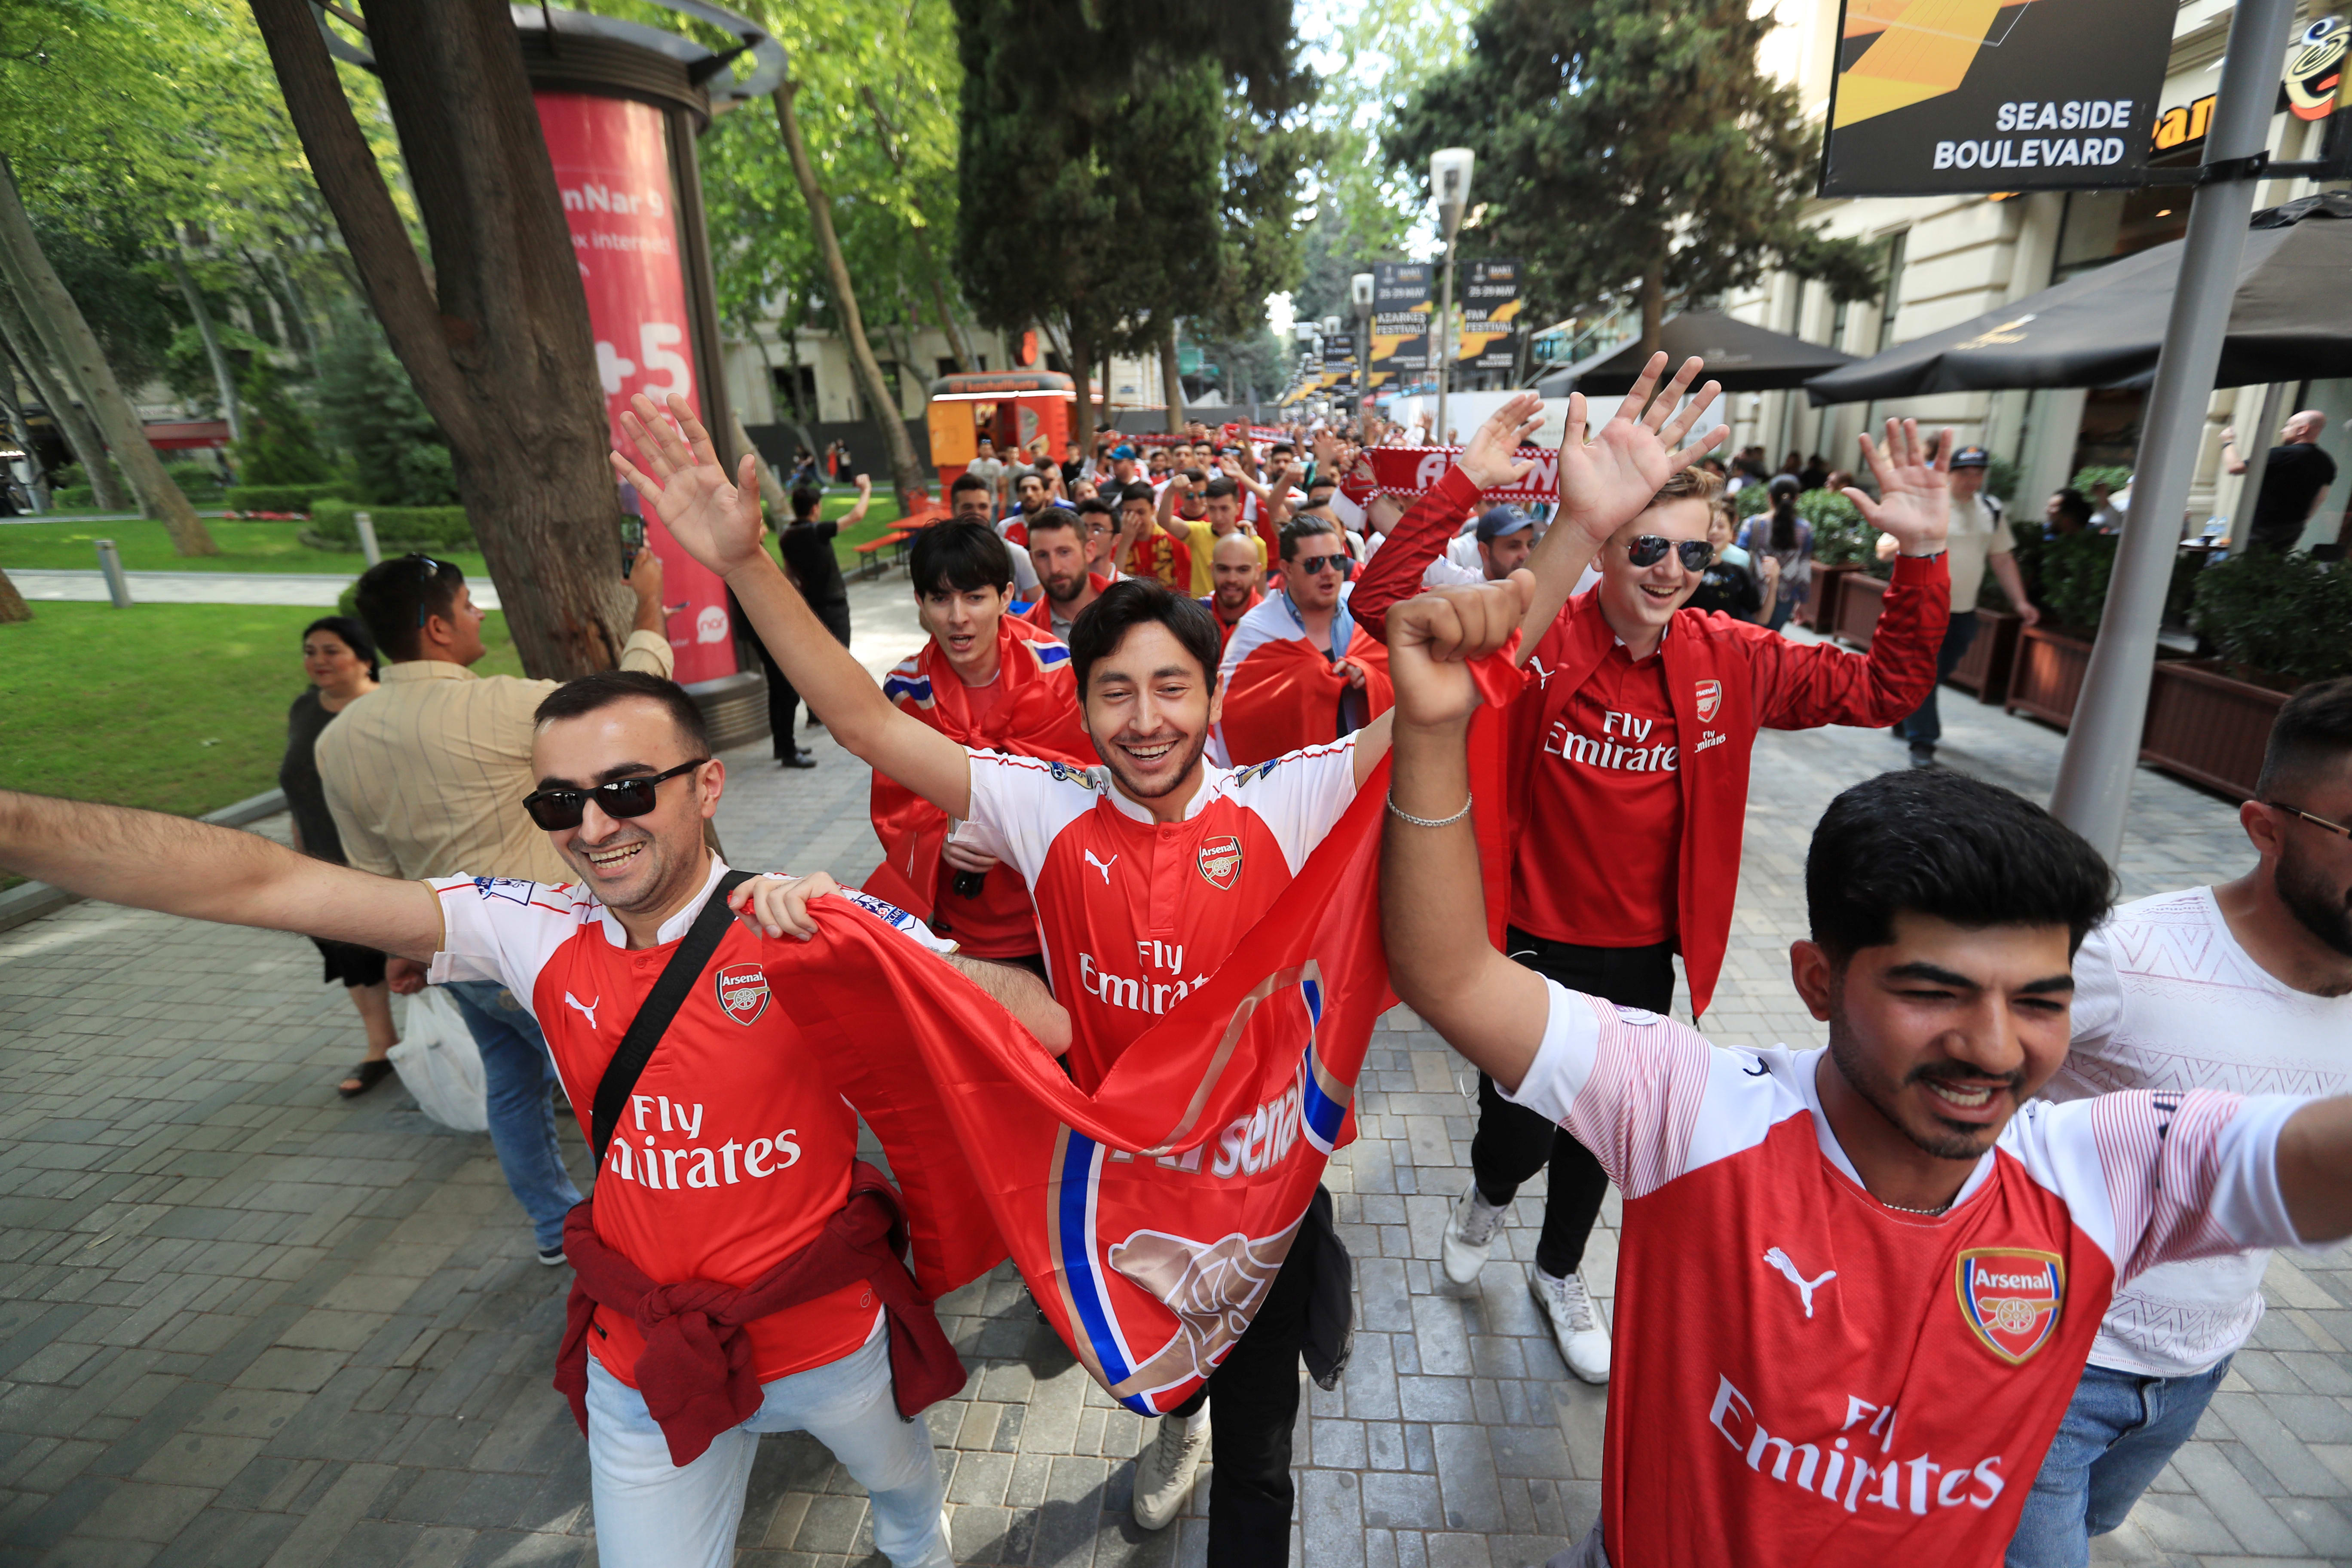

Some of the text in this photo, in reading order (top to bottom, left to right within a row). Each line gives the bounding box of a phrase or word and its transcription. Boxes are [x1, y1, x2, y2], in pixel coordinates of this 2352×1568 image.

[1997, 101, 2132, 131] SEASIDE
[1933, 138, 2124, 169] BOULEVARD
[1696, 686, 1716, 697] rsenal
[1603, 710, 1652, 743] Fly
[1201, 842, 1235, 858] Arsenal
[1137, 940, 1183, 975] Fly
[722, 971, 763, 986] Arsenal
[631, 1095, 703, 1139] Fly
[604, 1129, 801, 1190] mirates
[1975, 1268, 2049, 1290] Arsenal
